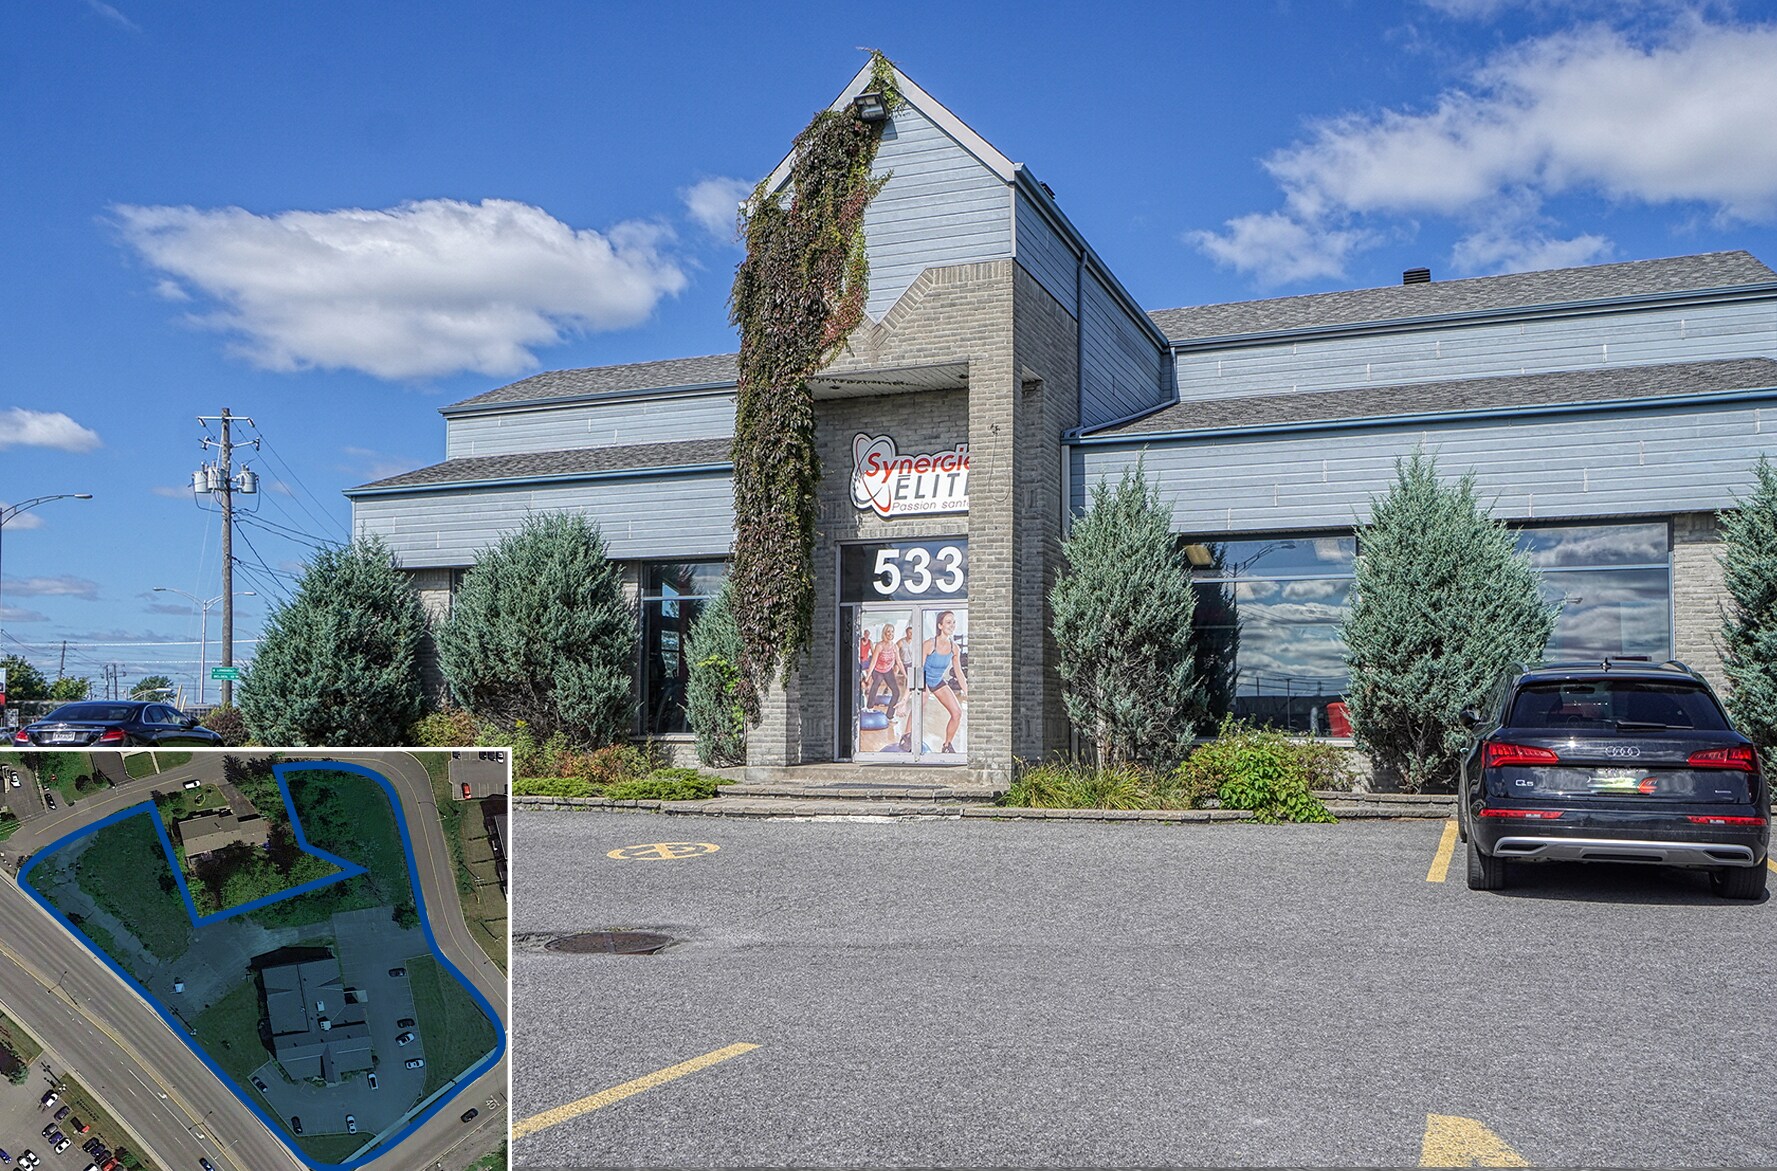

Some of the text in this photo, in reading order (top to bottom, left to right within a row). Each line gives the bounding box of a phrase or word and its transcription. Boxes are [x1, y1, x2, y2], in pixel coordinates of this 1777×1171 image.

[892, 500, 969, 511] Passion sant
[872, 546, 965, 595] 533
[1515, 779, 1534, 787] Q5
